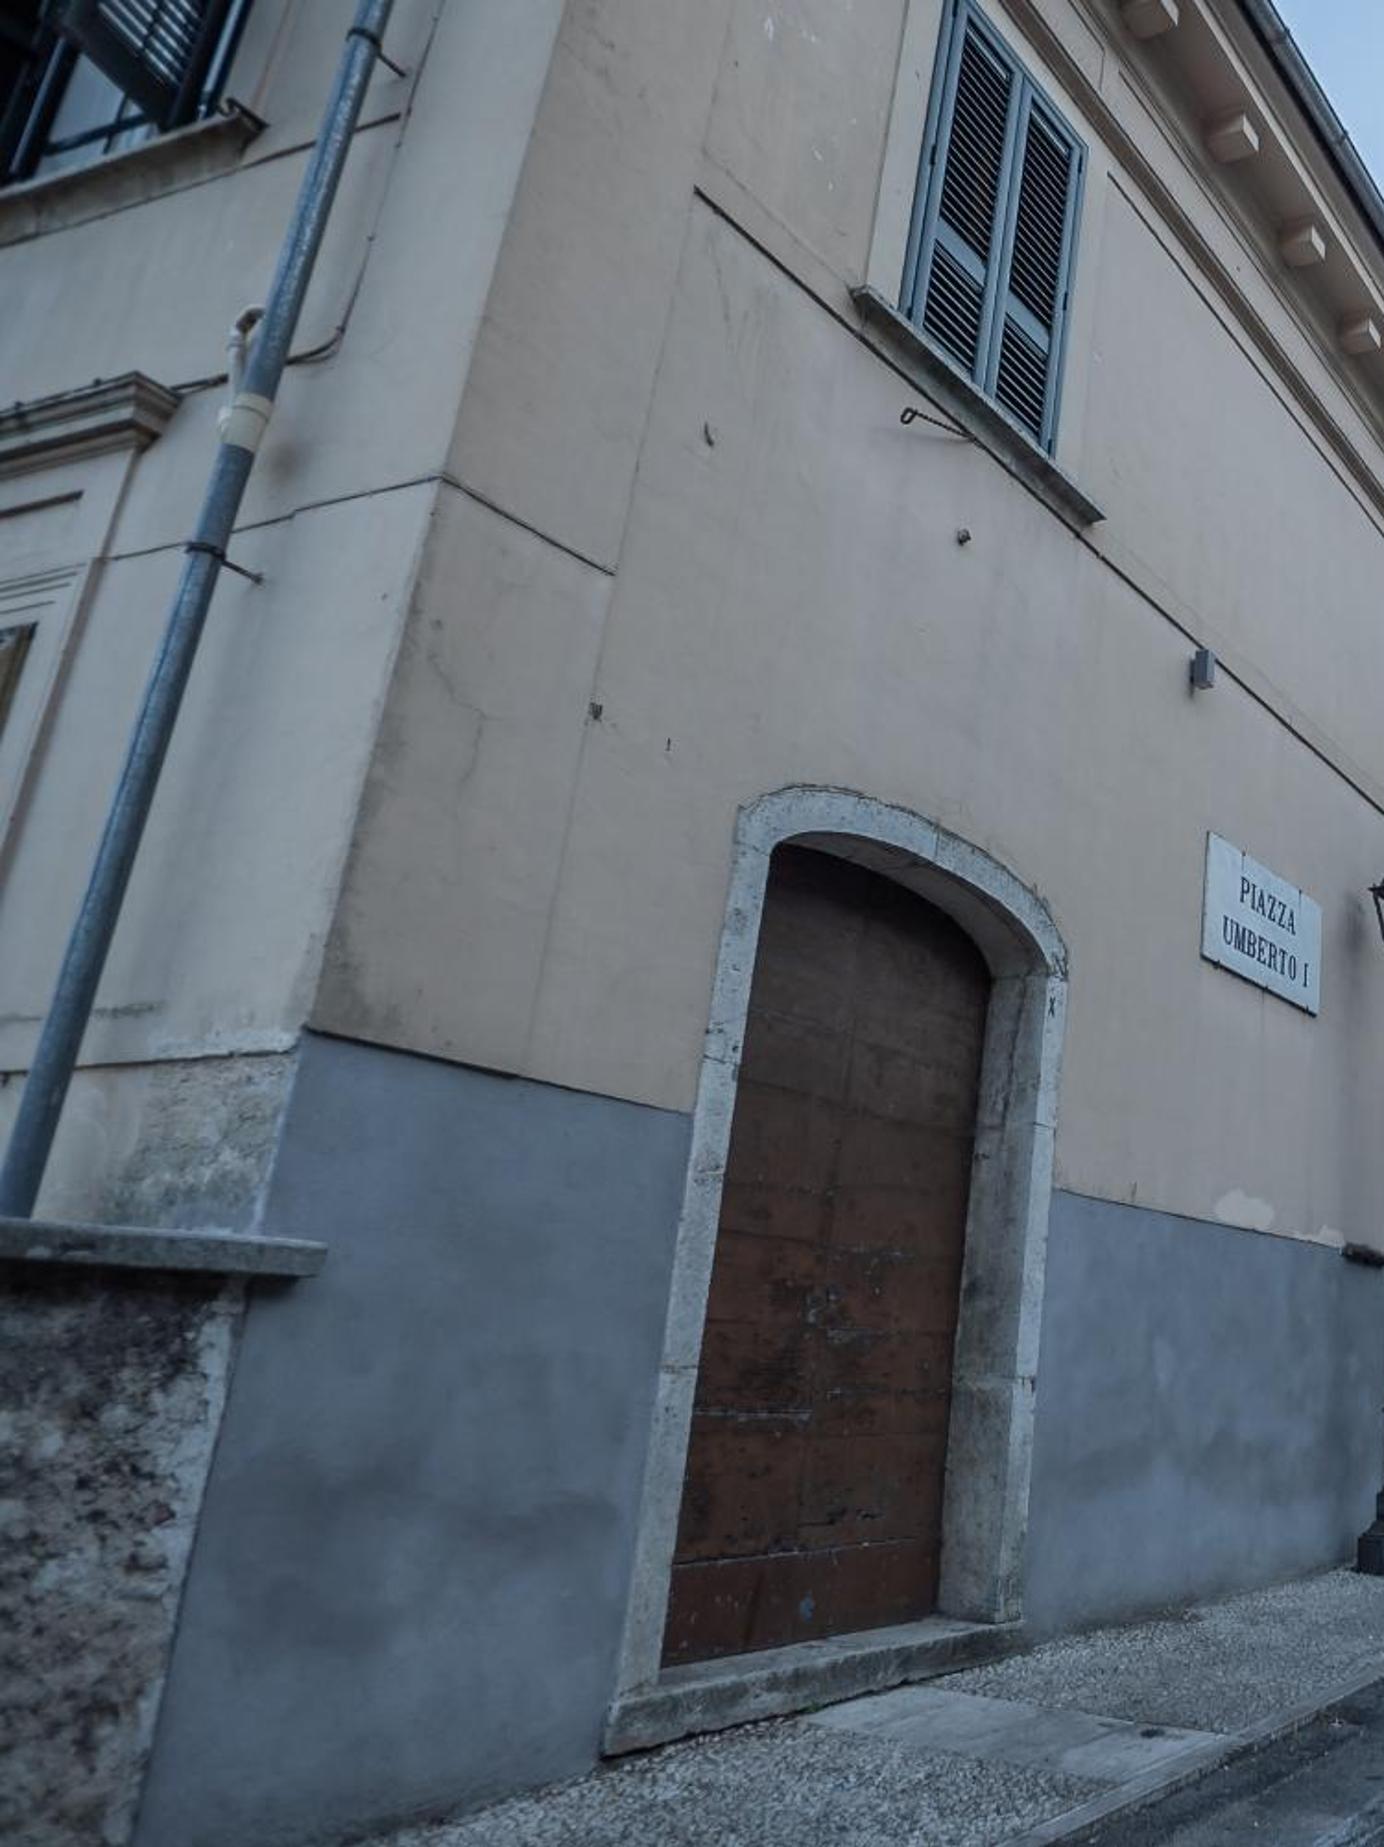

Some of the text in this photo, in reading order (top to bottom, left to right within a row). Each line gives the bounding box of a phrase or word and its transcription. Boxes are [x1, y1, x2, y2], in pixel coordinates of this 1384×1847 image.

[1239, 876, 1296, 936] PIAZZA
[1222, 914, 1309, 988] UMBERTO I
